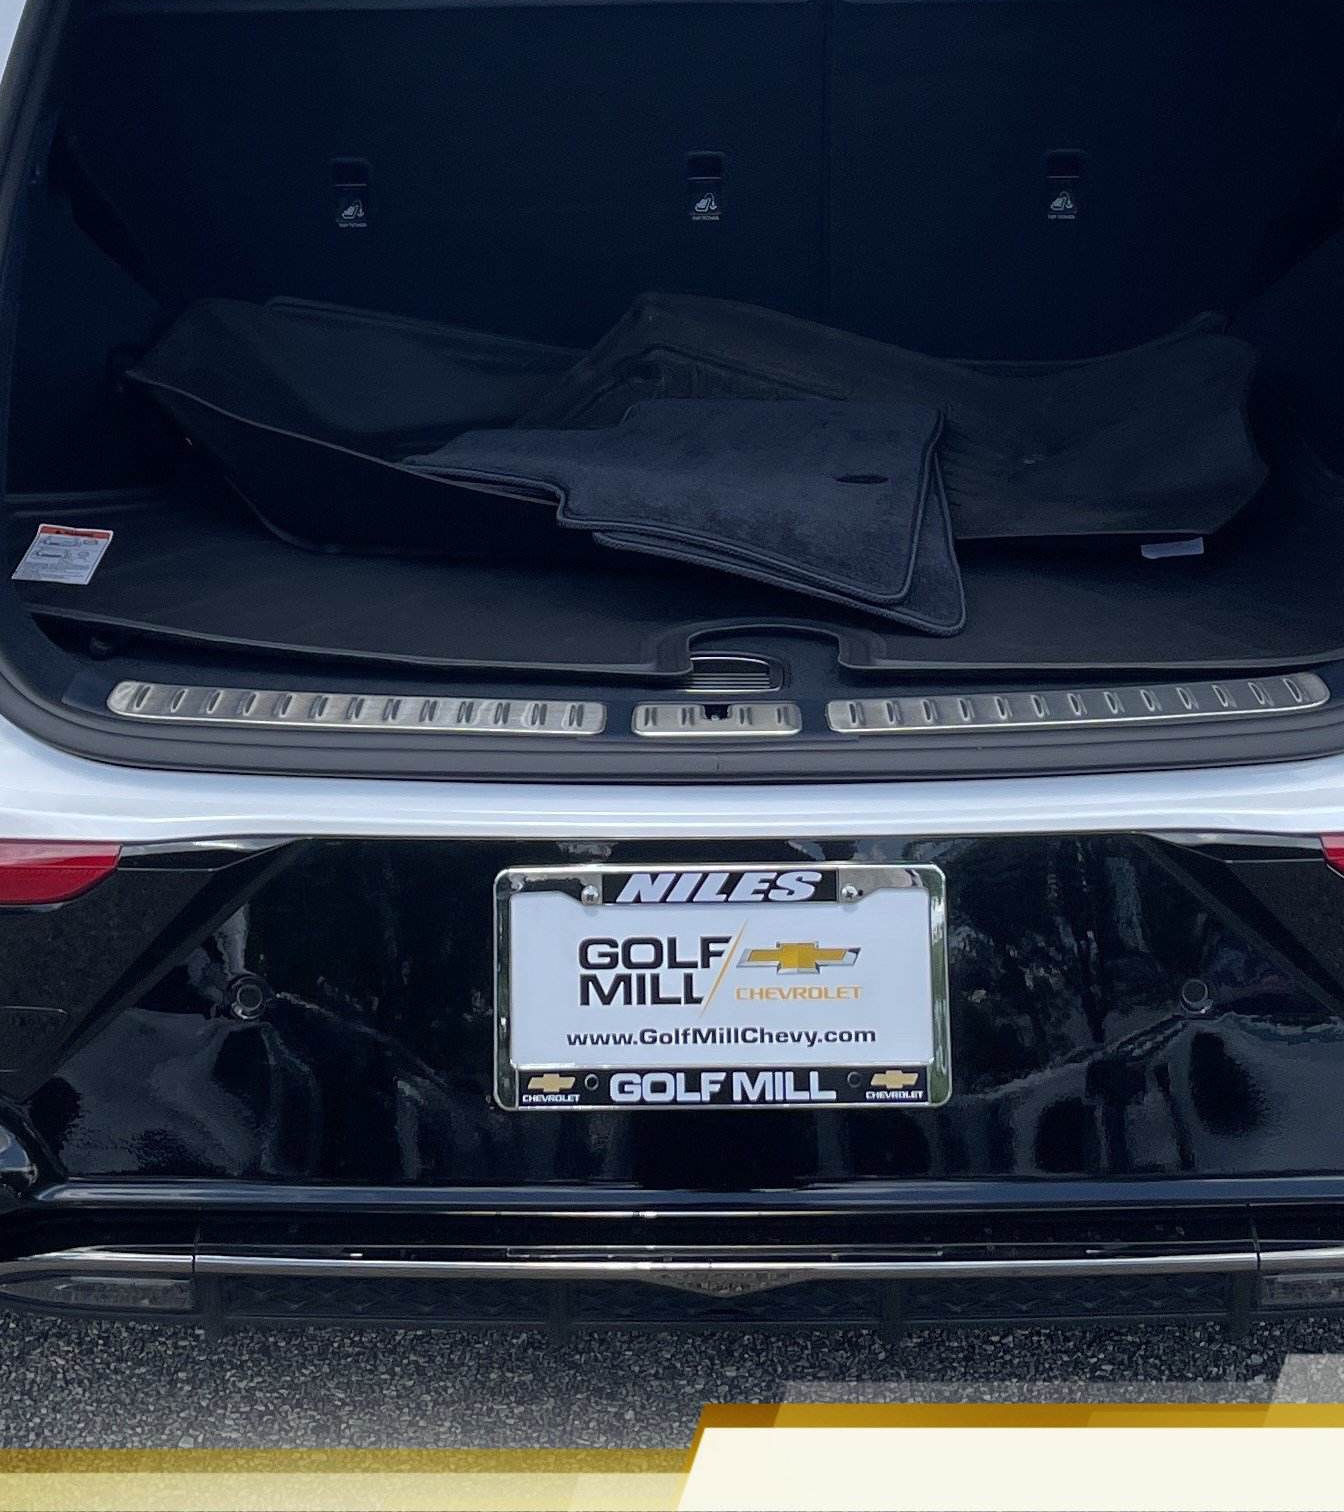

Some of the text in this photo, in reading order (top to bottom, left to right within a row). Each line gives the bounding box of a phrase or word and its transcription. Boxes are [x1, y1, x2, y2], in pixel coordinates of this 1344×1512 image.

[615, 871, 822, 903] NILES
[578, 935, 733, 970] GOLF
[578, 972, 704, 1006] MILL
[735, 985, 863, 1001] CHEVROLET
[566, 1027, 877, 1048] www.GolfMillChevy.com
[522, 1092, 580, 1103] CHEVROLET
[610, 1070, 837, 1104] GOLF MILL
[866, 1090, 923, 1100] CHEVROLET
